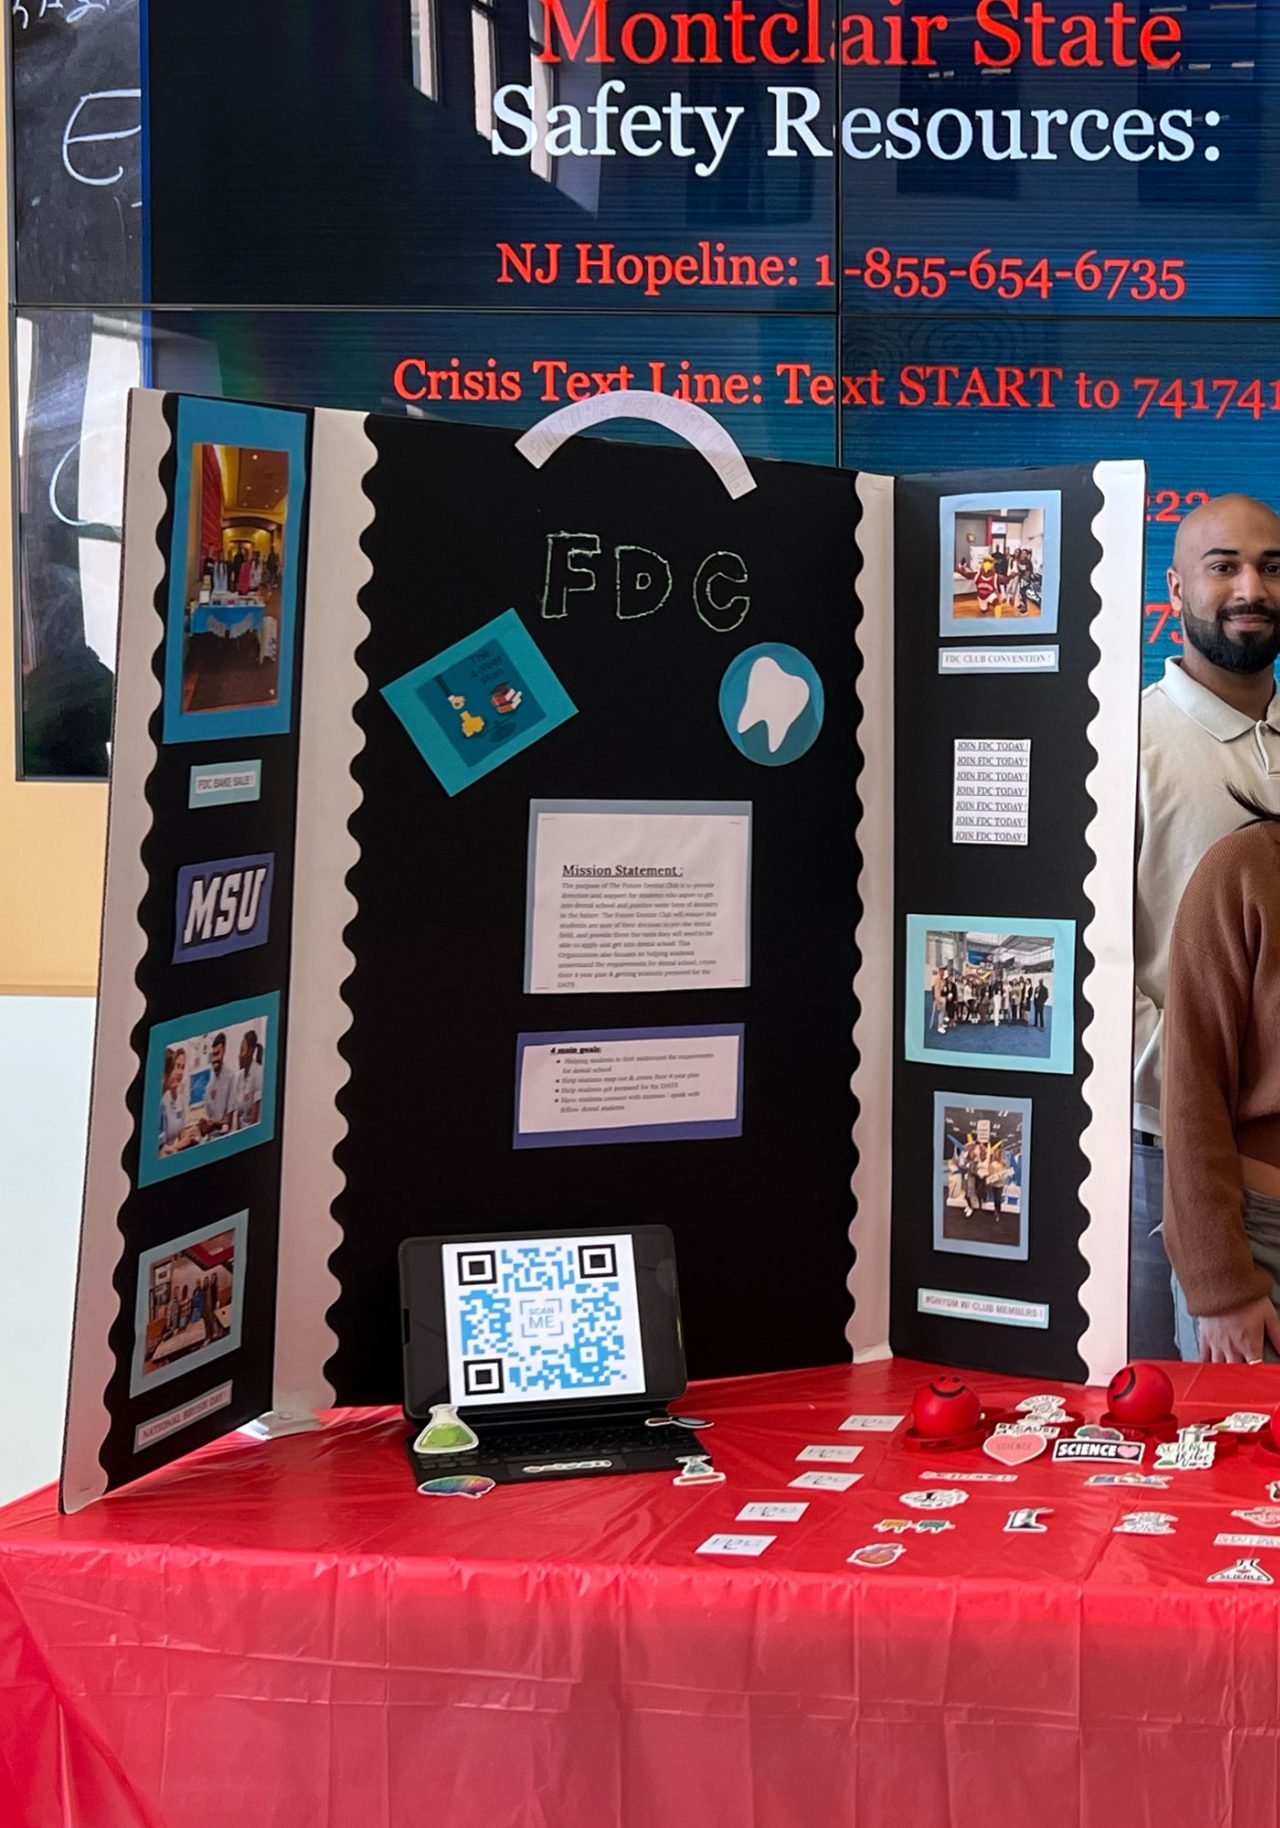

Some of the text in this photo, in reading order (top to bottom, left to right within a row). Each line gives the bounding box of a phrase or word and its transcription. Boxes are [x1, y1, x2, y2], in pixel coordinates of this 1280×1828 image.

[539, 0, 1183, 69] Montclair State
[492, 80, 1221, 176] Safety Resources:
[497, 241, 1187, 300] NJ Hopeline: 1-855-654-6735
[393, 358, 522, 401] Crisis
[532, 360, 634, 402] Text
[648, 360, 762, 404] Line:
[776, 362, 885, 406] Text
[899, 365, 1064, 408] START
[1075, 371, 1120, 409] to
[542, 530, 750, 632] FDC
[963, 654, 986, 664] CLUB
[562, 864, 612, 877] Mission
[615, 864, 676, 877] Statement
[184, 868, 267, 944] MSU
[528, 1315, 555, 1328] ME
[1058, 1443, 1118, 1457] SCIENCE
